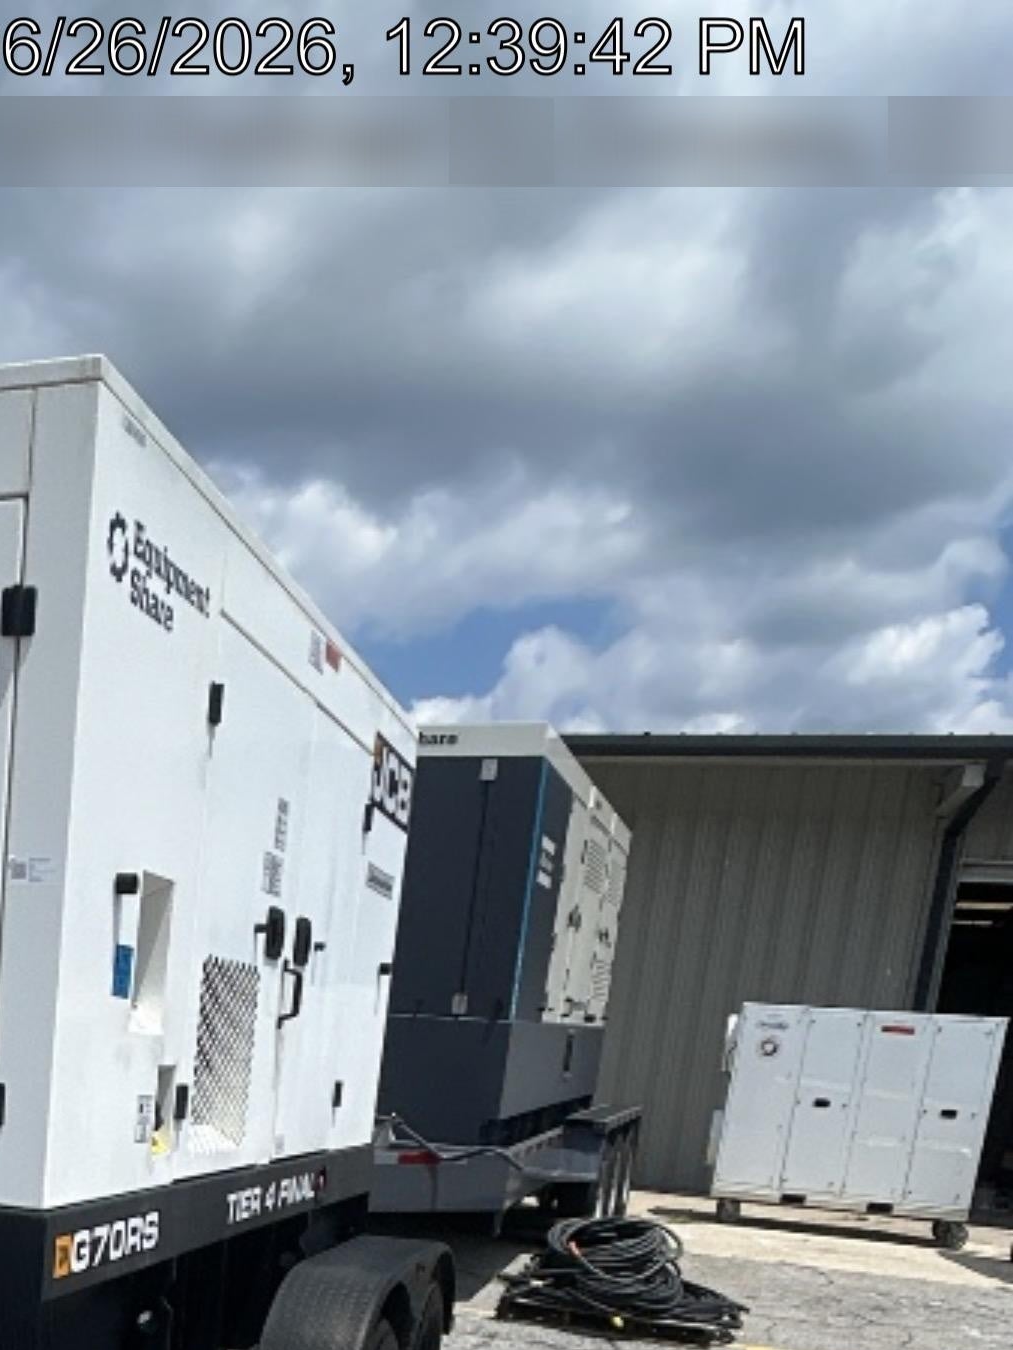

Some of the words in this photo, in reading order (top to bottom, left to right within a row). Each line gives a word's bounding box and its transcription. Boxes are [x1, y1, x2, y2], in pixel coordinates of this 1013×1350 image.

[130, 567, 173, 632] Share
[133, 520, 209, 619] Equipment
[70, 1211, 159, 1273] G70RS
[227, 1185, 262, 1224] TIER
[265, 1181, 276, 1212] 4
[278, 1172, 316, 1210] FINAL
